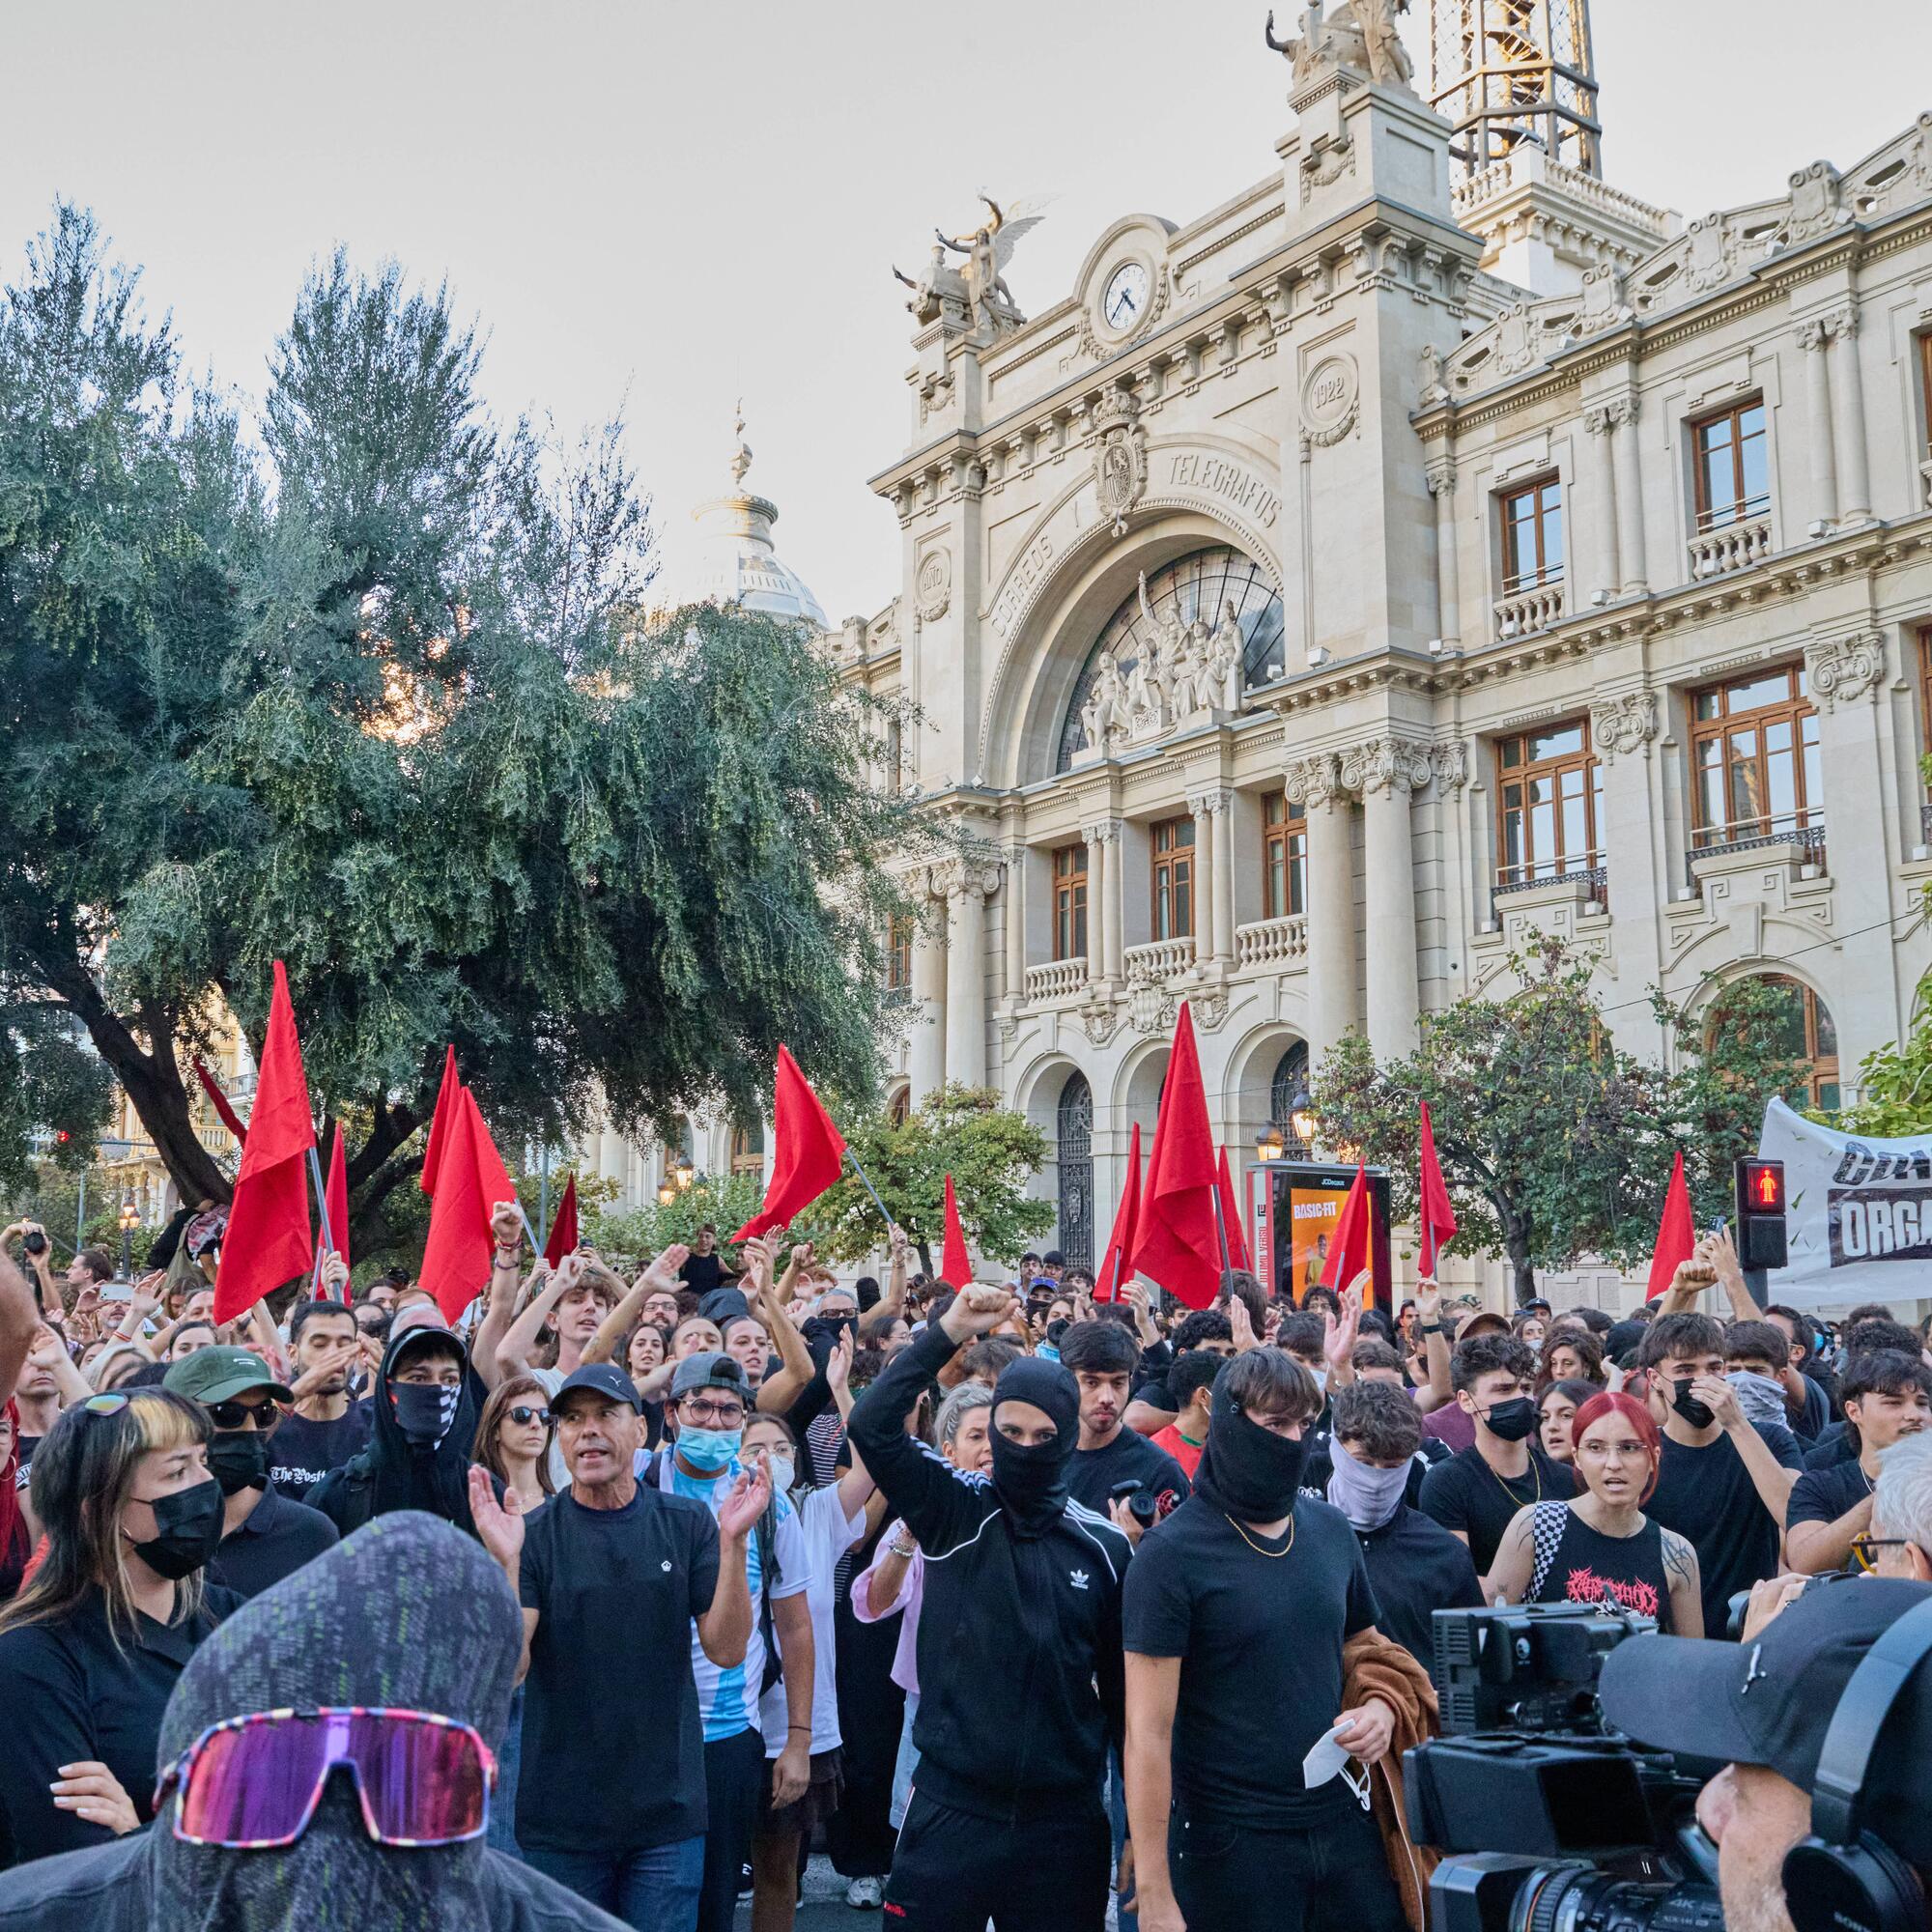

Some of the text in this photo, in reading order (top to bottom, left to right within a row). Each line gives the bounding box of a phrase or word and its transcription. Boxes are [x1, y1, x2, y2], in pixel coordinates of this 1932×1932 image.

[1314, 378, 1345, 409] 1922
[991, 535, 1053, 638] CORREOS
[1170, 455, 1283, 528] TELEGRAFOS
[270, 1466, 293, 1484] The
